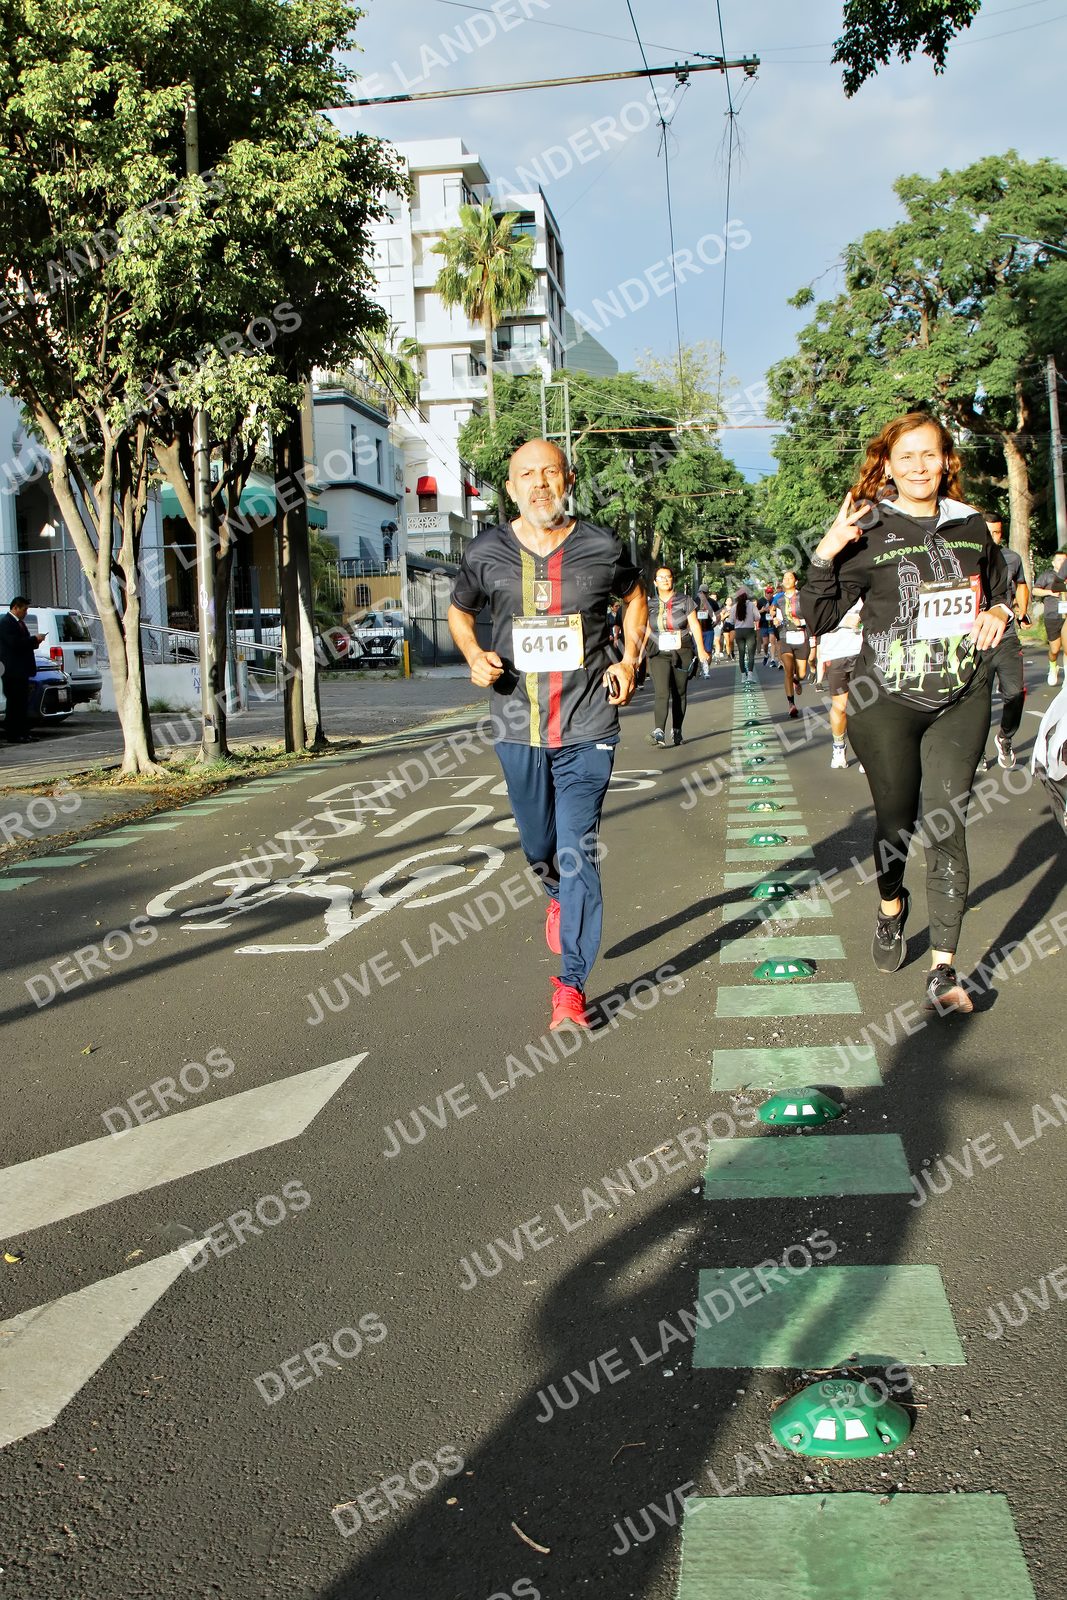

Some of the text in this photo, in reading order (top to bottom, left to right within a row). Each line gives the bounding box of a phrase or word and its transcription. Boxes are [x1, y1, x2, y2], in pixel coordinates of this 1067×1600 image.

[873, 545, 929, 564] ZAPOPAN
[923, 595, 973, 618] 11255
[522, 635, 568, 653] 6416
